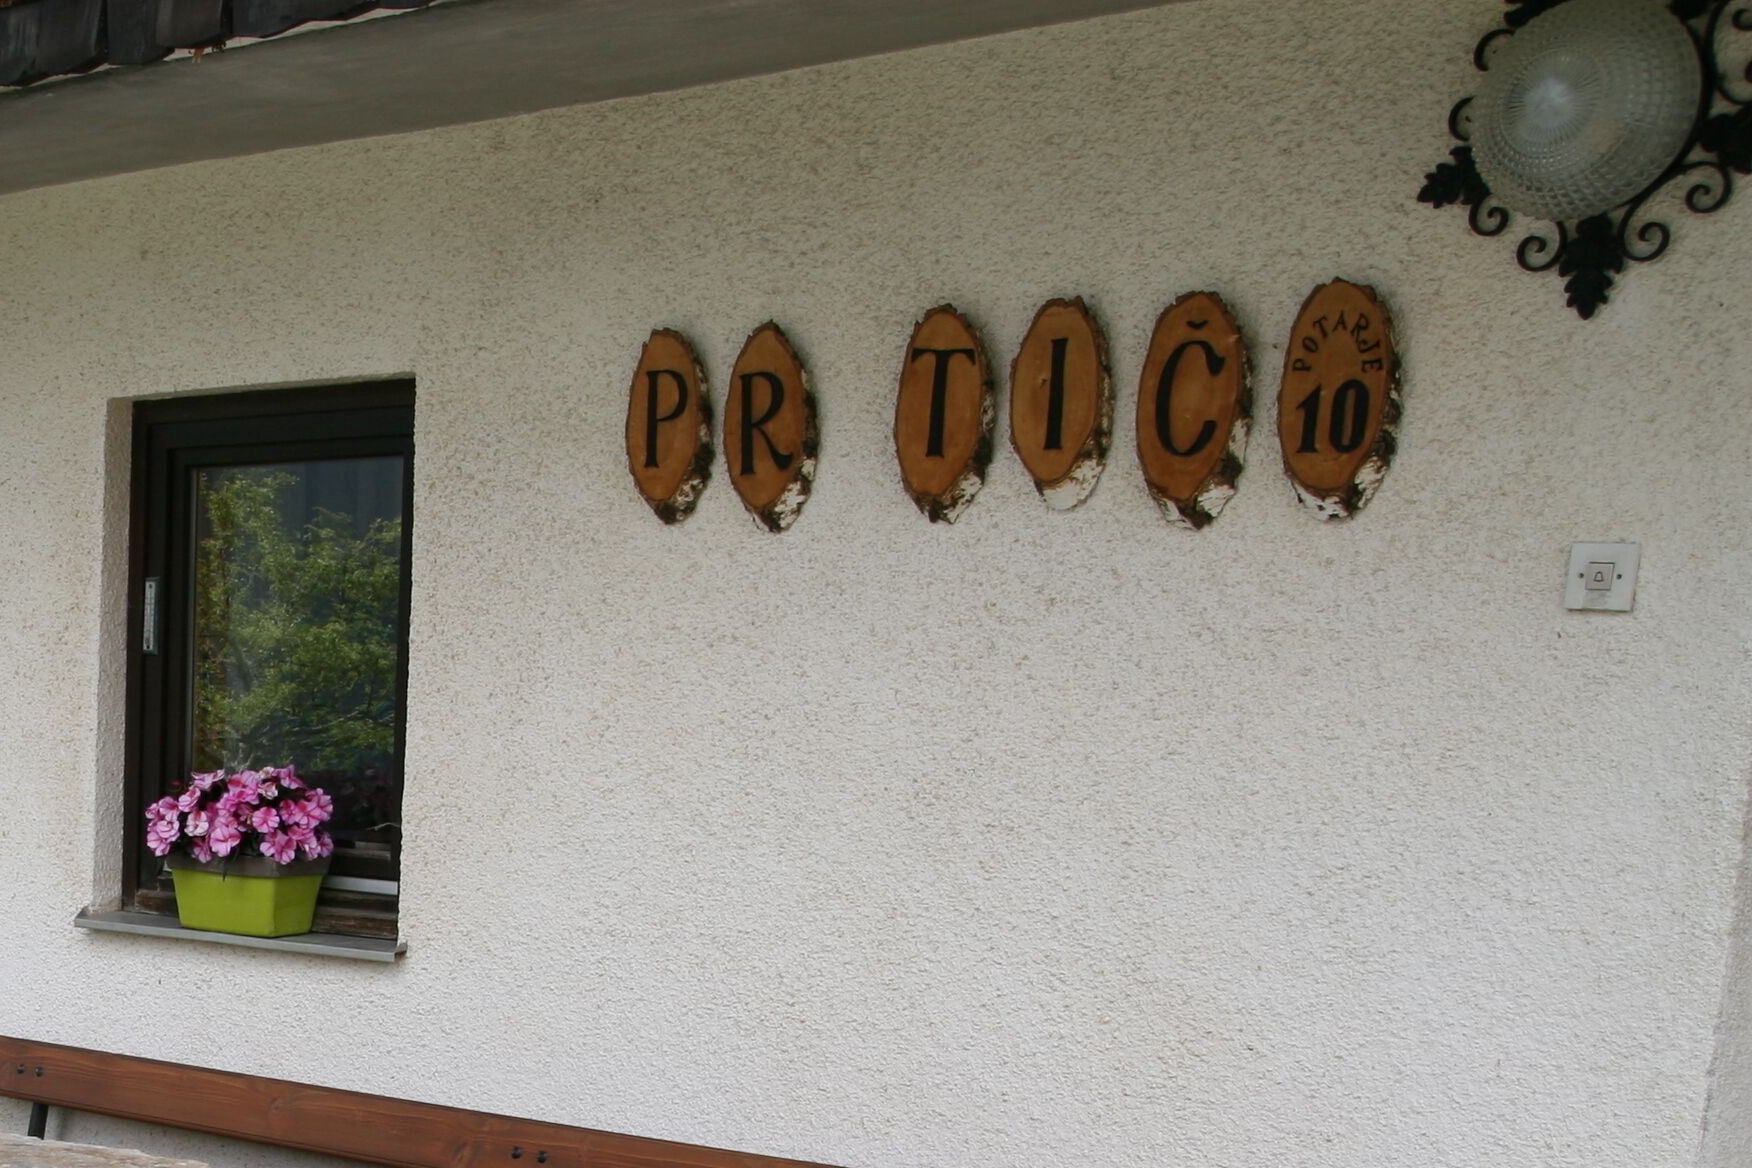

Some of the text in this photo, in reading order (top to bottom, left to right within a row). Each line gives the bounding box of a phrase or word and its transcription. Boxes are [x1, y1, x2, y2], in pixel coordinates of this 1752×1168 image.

[1292, 310, 1384, 374] POTARJE
[644, 319, 1226, 476] PR TIČ
[1296, 379, 1370, 454] 10
